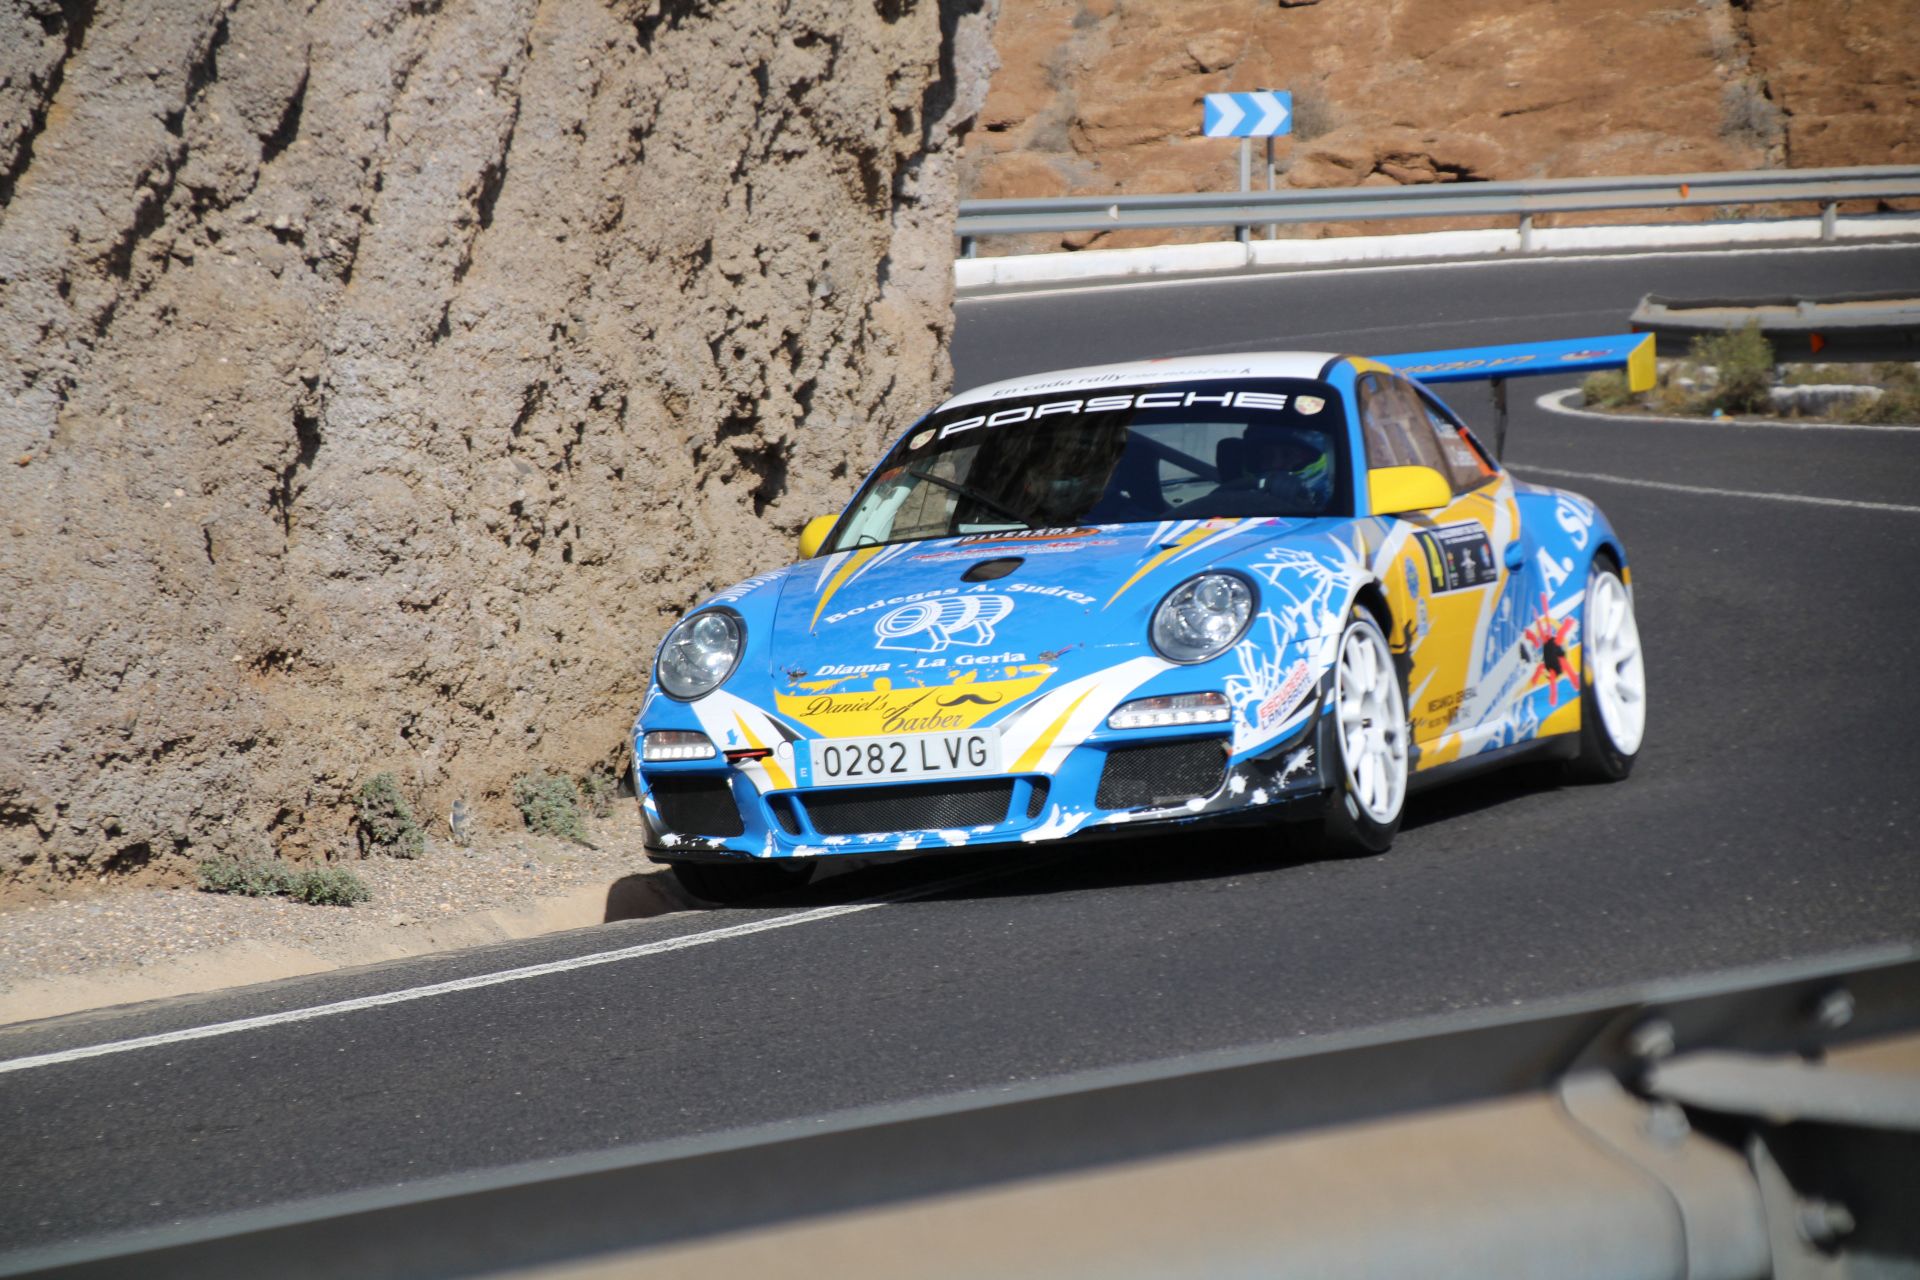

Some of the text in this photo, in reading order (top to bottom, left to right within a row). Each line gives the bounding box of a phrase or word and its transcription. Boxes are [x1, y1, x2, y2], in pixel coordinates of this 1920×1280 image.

[1024, 379, 1073, 392] cada
[1077, 372, 1127, 387] rally
[938, 391, 1289, 440] PORSCHE
[823, 583, 1097, 624] Bodegas A. Suárez
[814, 662, 890, 677] Diama
[916, 657, 947, 669] La
[955, 651, 1027, 666] Geria
[800, 693, 889, 717] Daniel's
[823, 736, 987, 778] 0282 LVG
[800, 767, 808, 778] E
